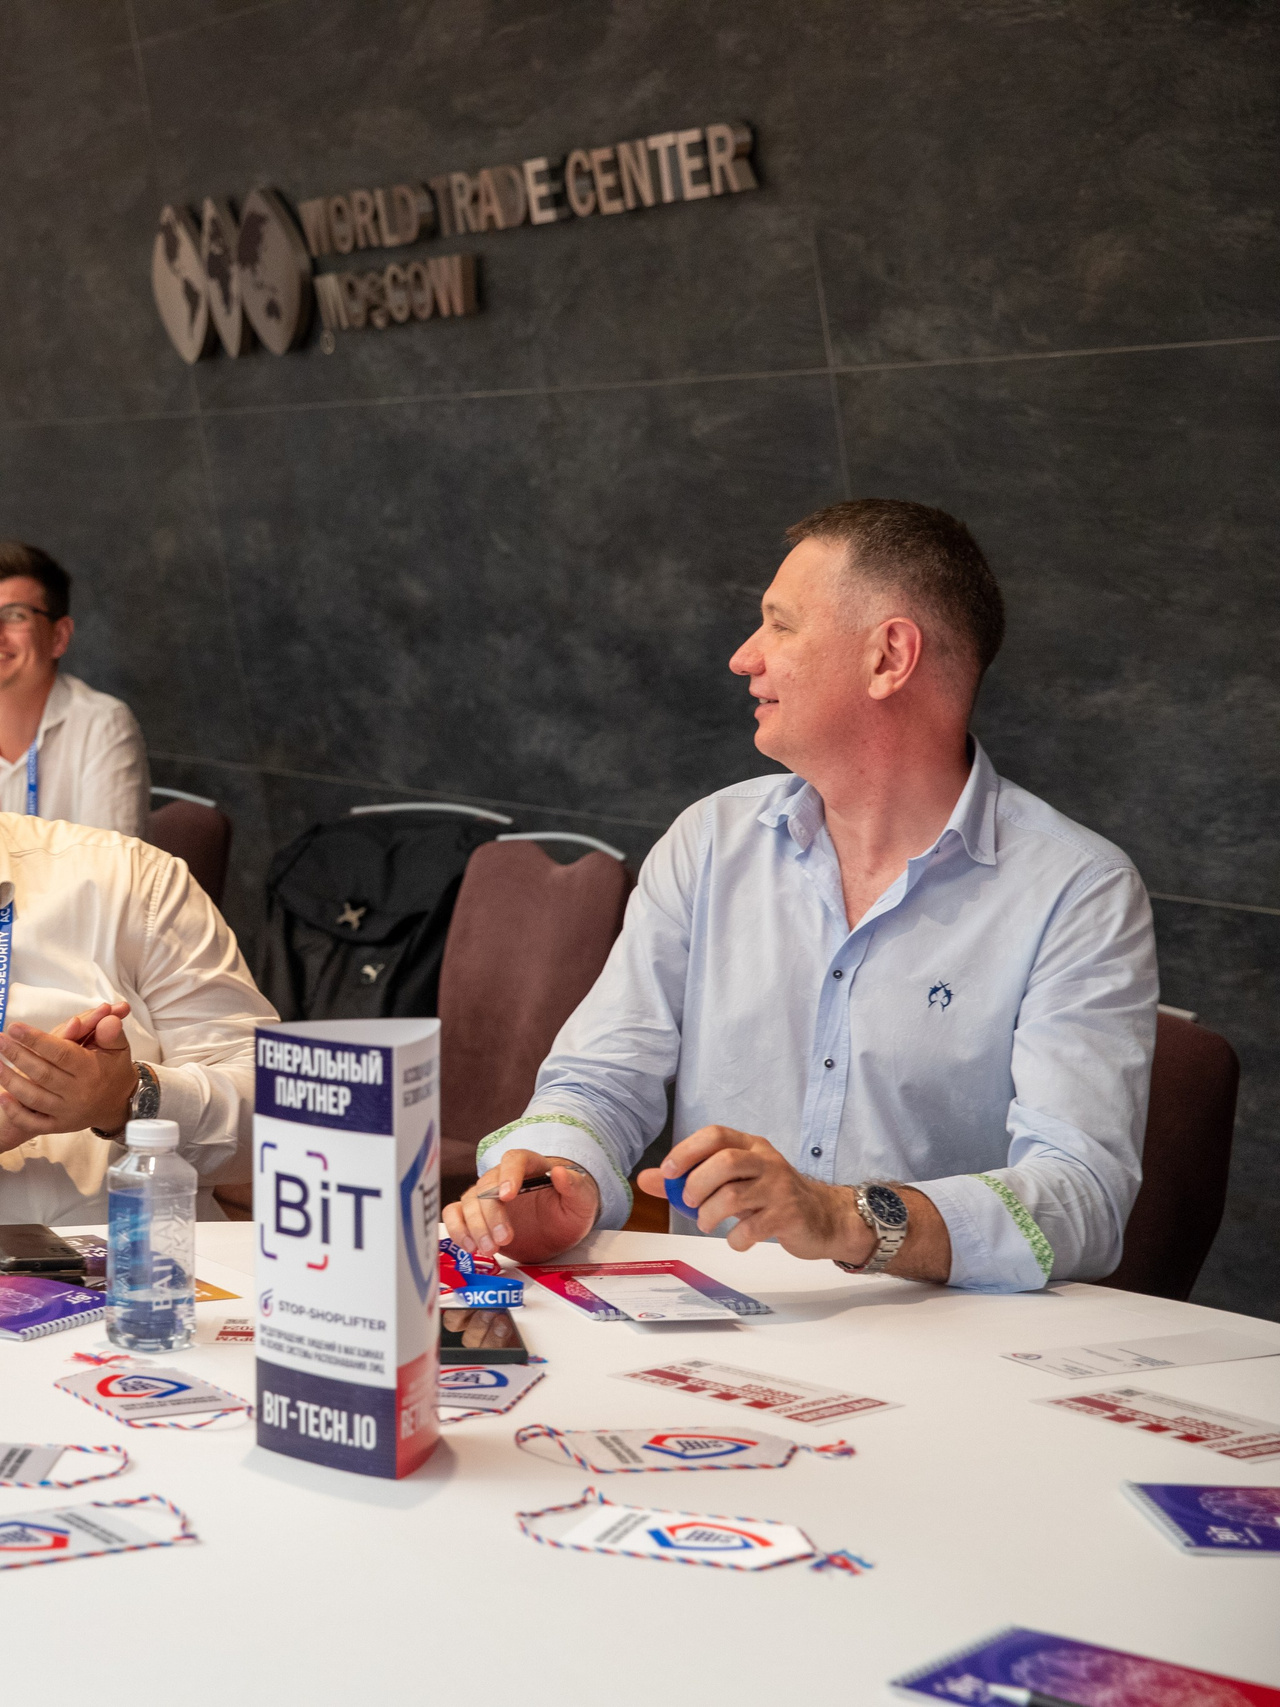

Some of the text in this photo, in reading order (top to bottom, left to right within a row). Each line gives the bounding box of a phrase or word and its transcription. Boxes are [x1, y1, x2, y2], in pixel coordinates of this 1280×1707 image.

[298, 123, 758, 256] WORLD TRADE CENTER
[314, 253, 478, 329] MOSCOW
[257, 1037, 383, 1085] ГЕНЕРАЛЬНЫЙ
[275, 1075, 351, 1117] ПАРТНЕР
[278, 1299, 387, 1331] STOP-SHOPLIFTER
[262, 1390, 377, 1451] BIT-TECH.IO
